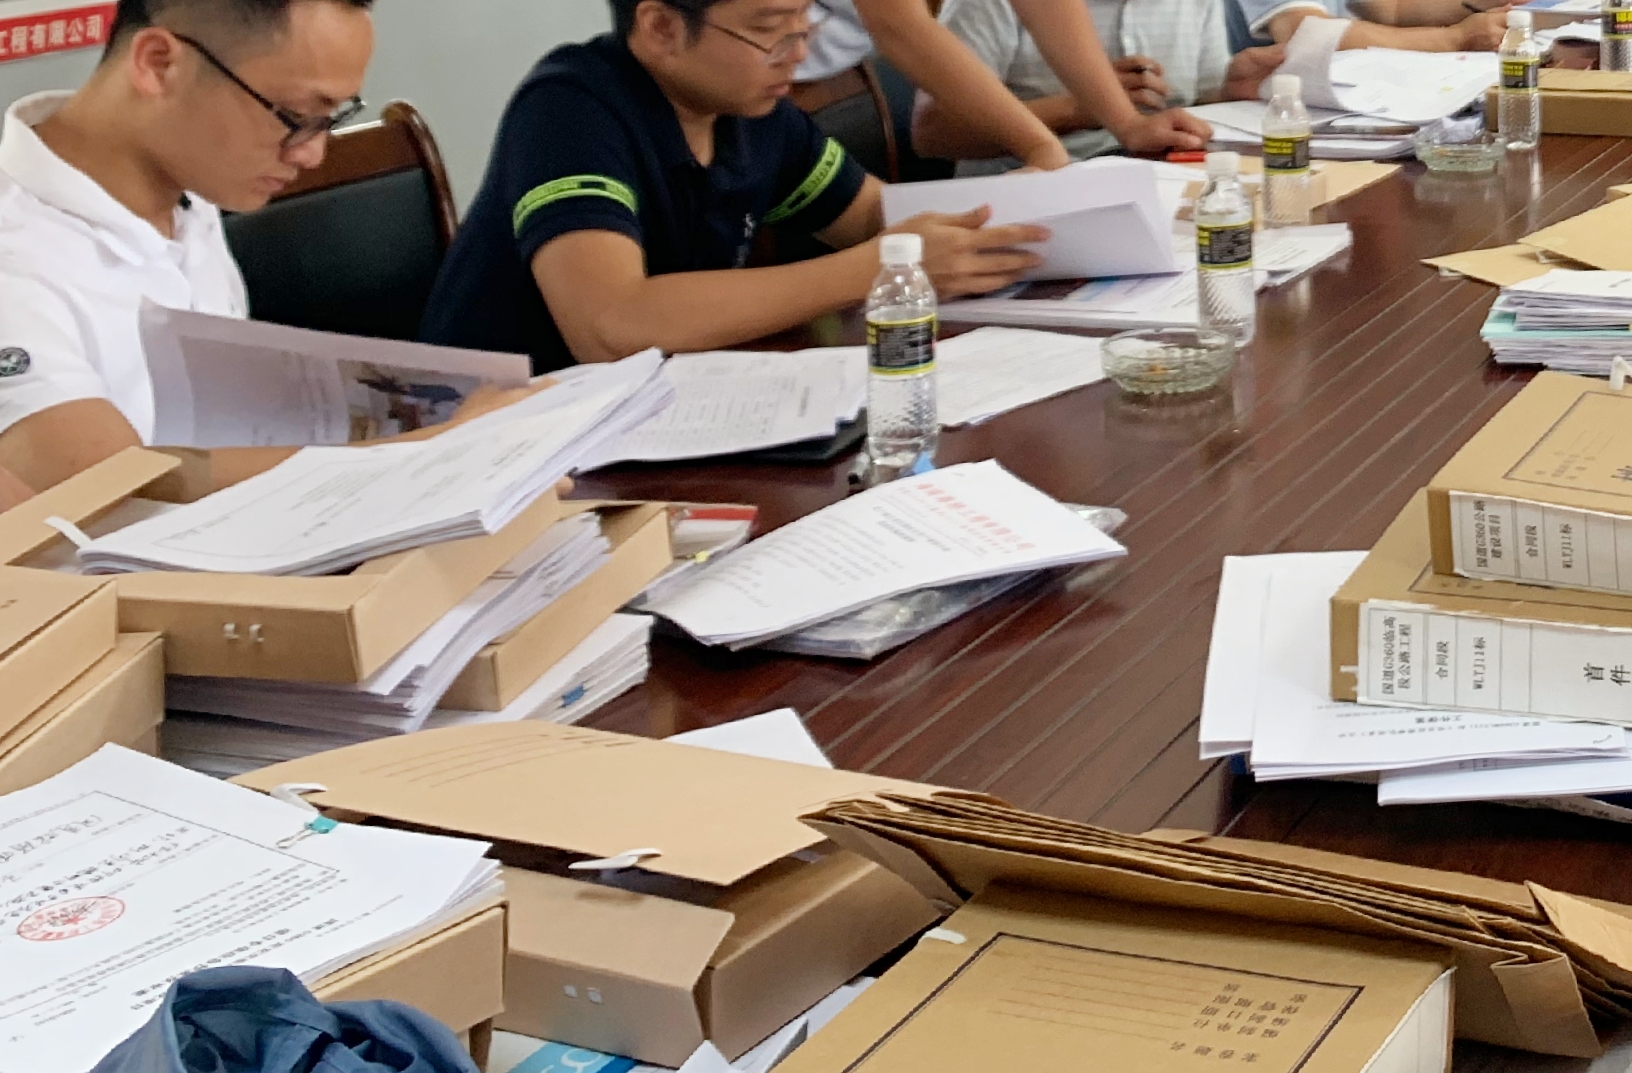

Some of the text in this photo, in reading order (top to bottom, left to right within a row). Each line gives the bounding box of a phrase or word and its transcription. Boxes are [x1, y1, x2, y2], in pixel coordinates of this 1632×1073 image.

[1525, 525, 1538, 557] 合同段
[1435, 640, 1449, 679] 合同段
